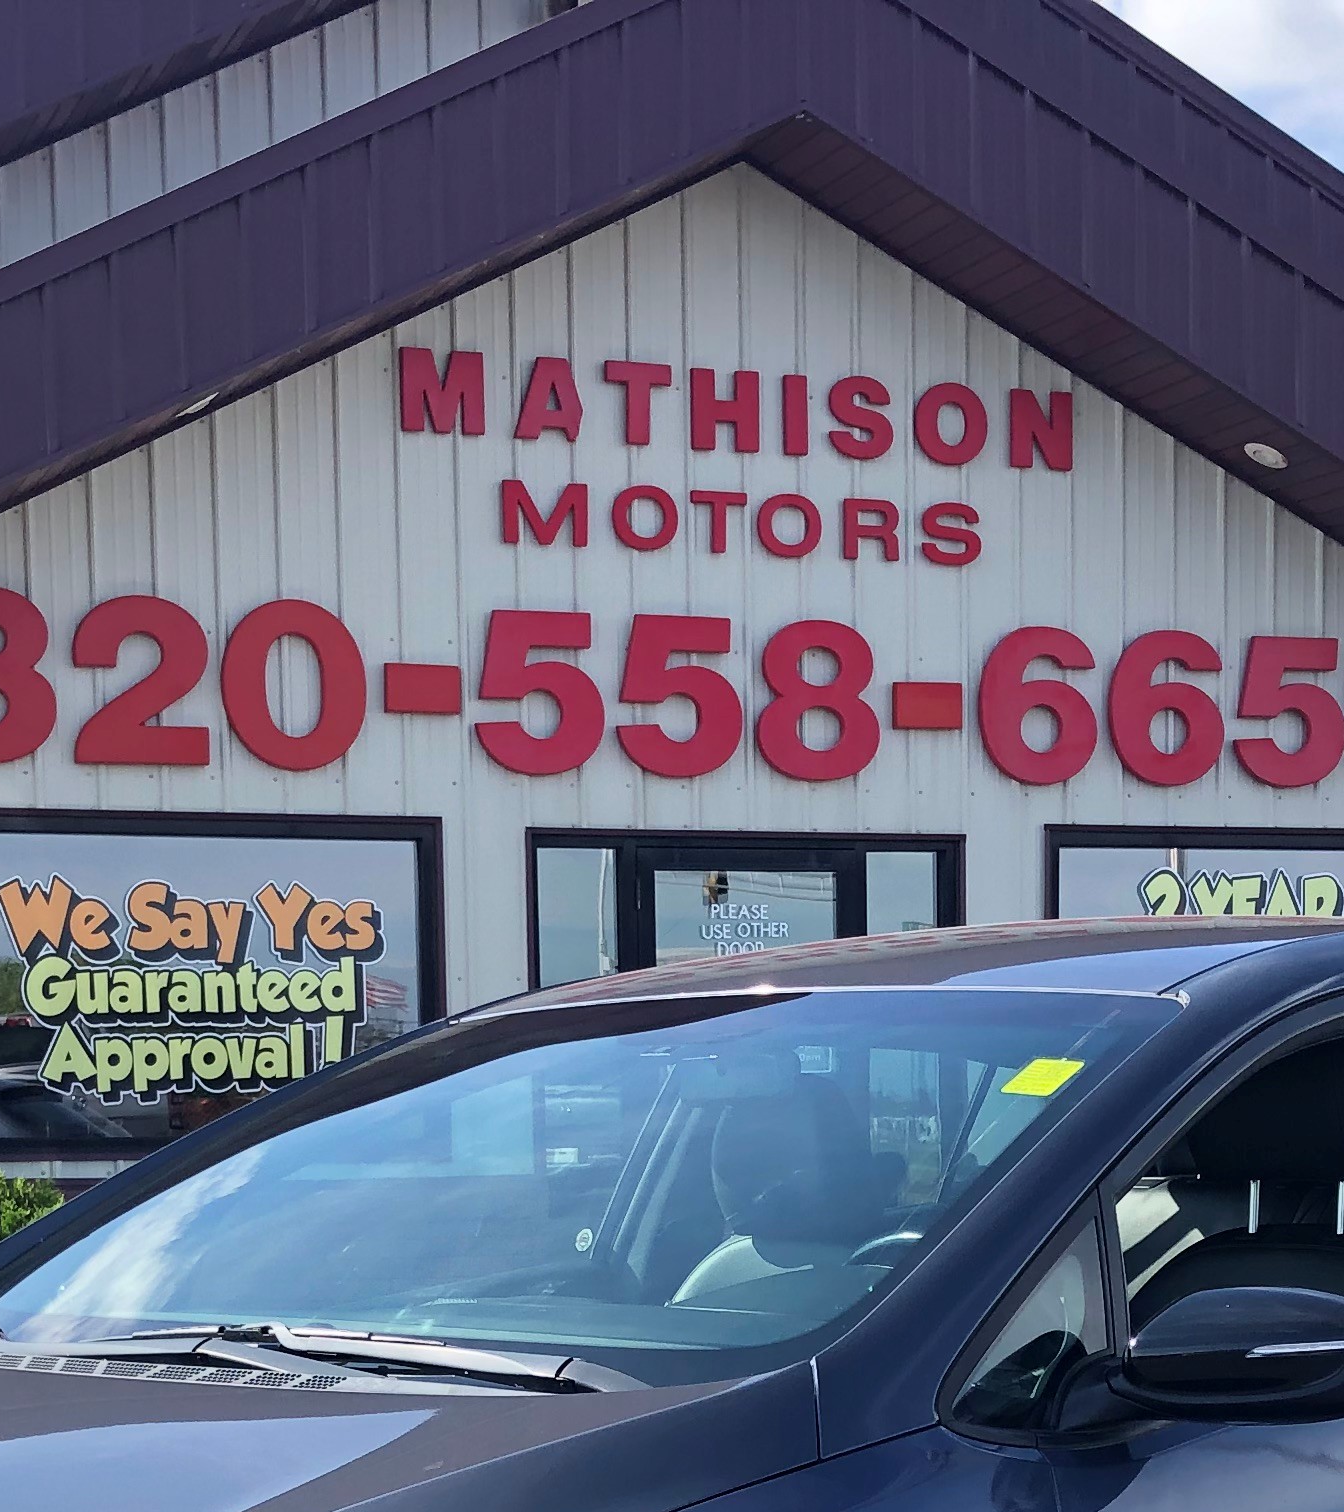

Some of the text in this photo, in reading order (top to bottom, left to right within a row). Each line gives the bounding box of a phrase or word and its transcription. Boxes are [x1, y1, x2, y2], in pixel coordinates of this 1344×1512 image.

[399, 346, 1073, 472] MATHISON
[501, 479, 983, 566] MOTORS
[128, 881, 249, 965] Say
[256, 881, 378, 953] Yes
[711, 903, 769, 919] PLEASE
[1144, 871, 1182, 916] 2
[702, 922, 789, 939] USE OTHER
[26, 957, 356, 1017] Guaranteed
